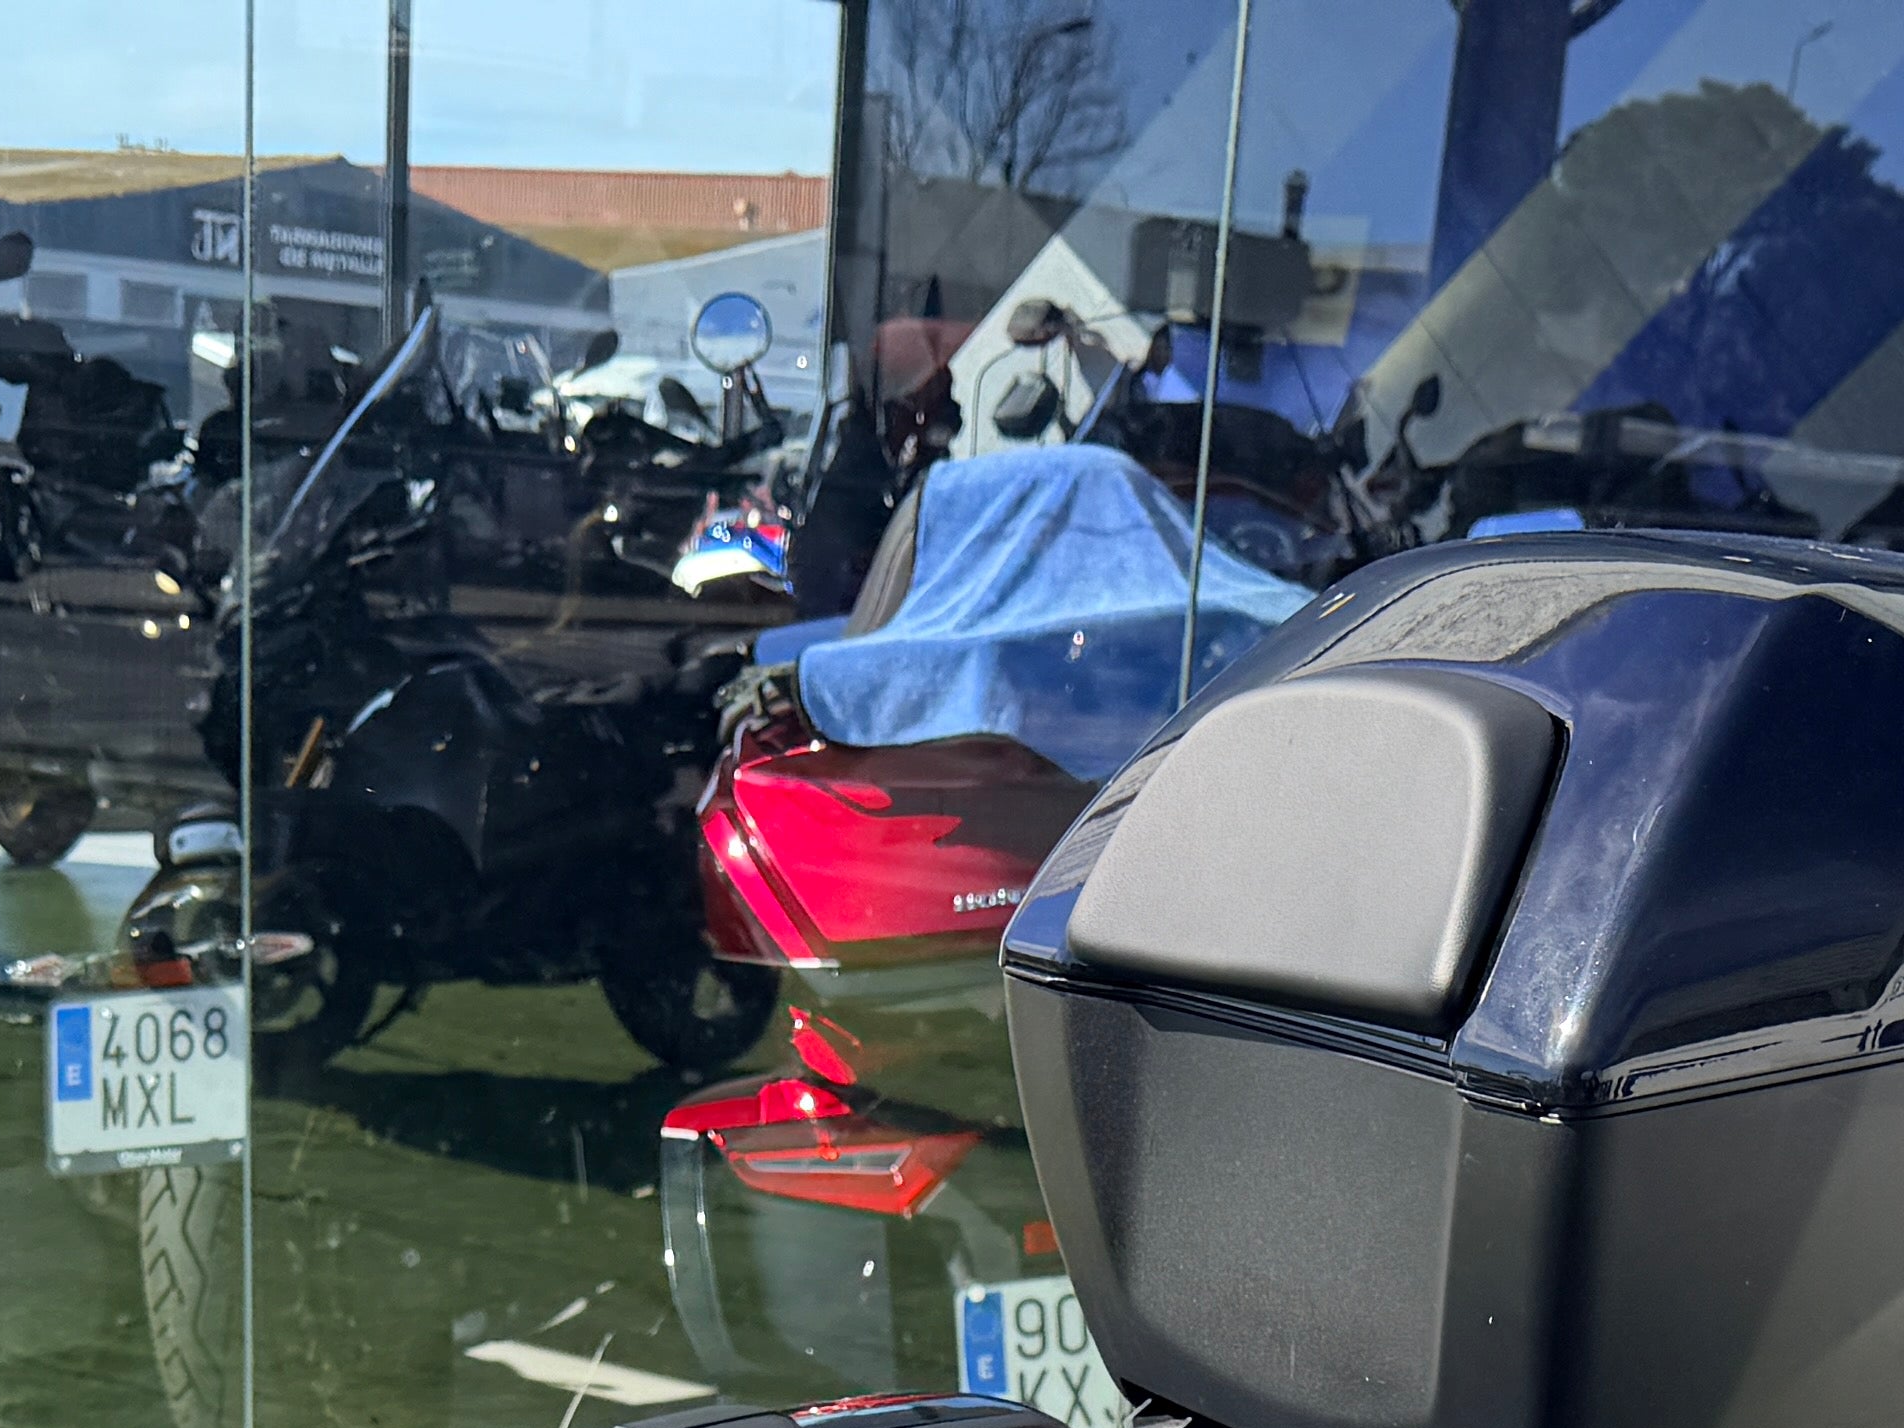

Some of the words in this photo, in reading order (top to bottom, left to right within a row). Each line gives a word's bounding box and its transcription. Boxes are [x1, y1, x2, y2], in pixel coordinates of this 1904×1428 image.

[100, 1005, 229, 1068] 4068
[64, 1063, 83, 1086] E
[101, 1071, 197, 1131] MXL
[976, 1354, 995, 1380] E
[1018, 1364, 1115, 1428] KX
